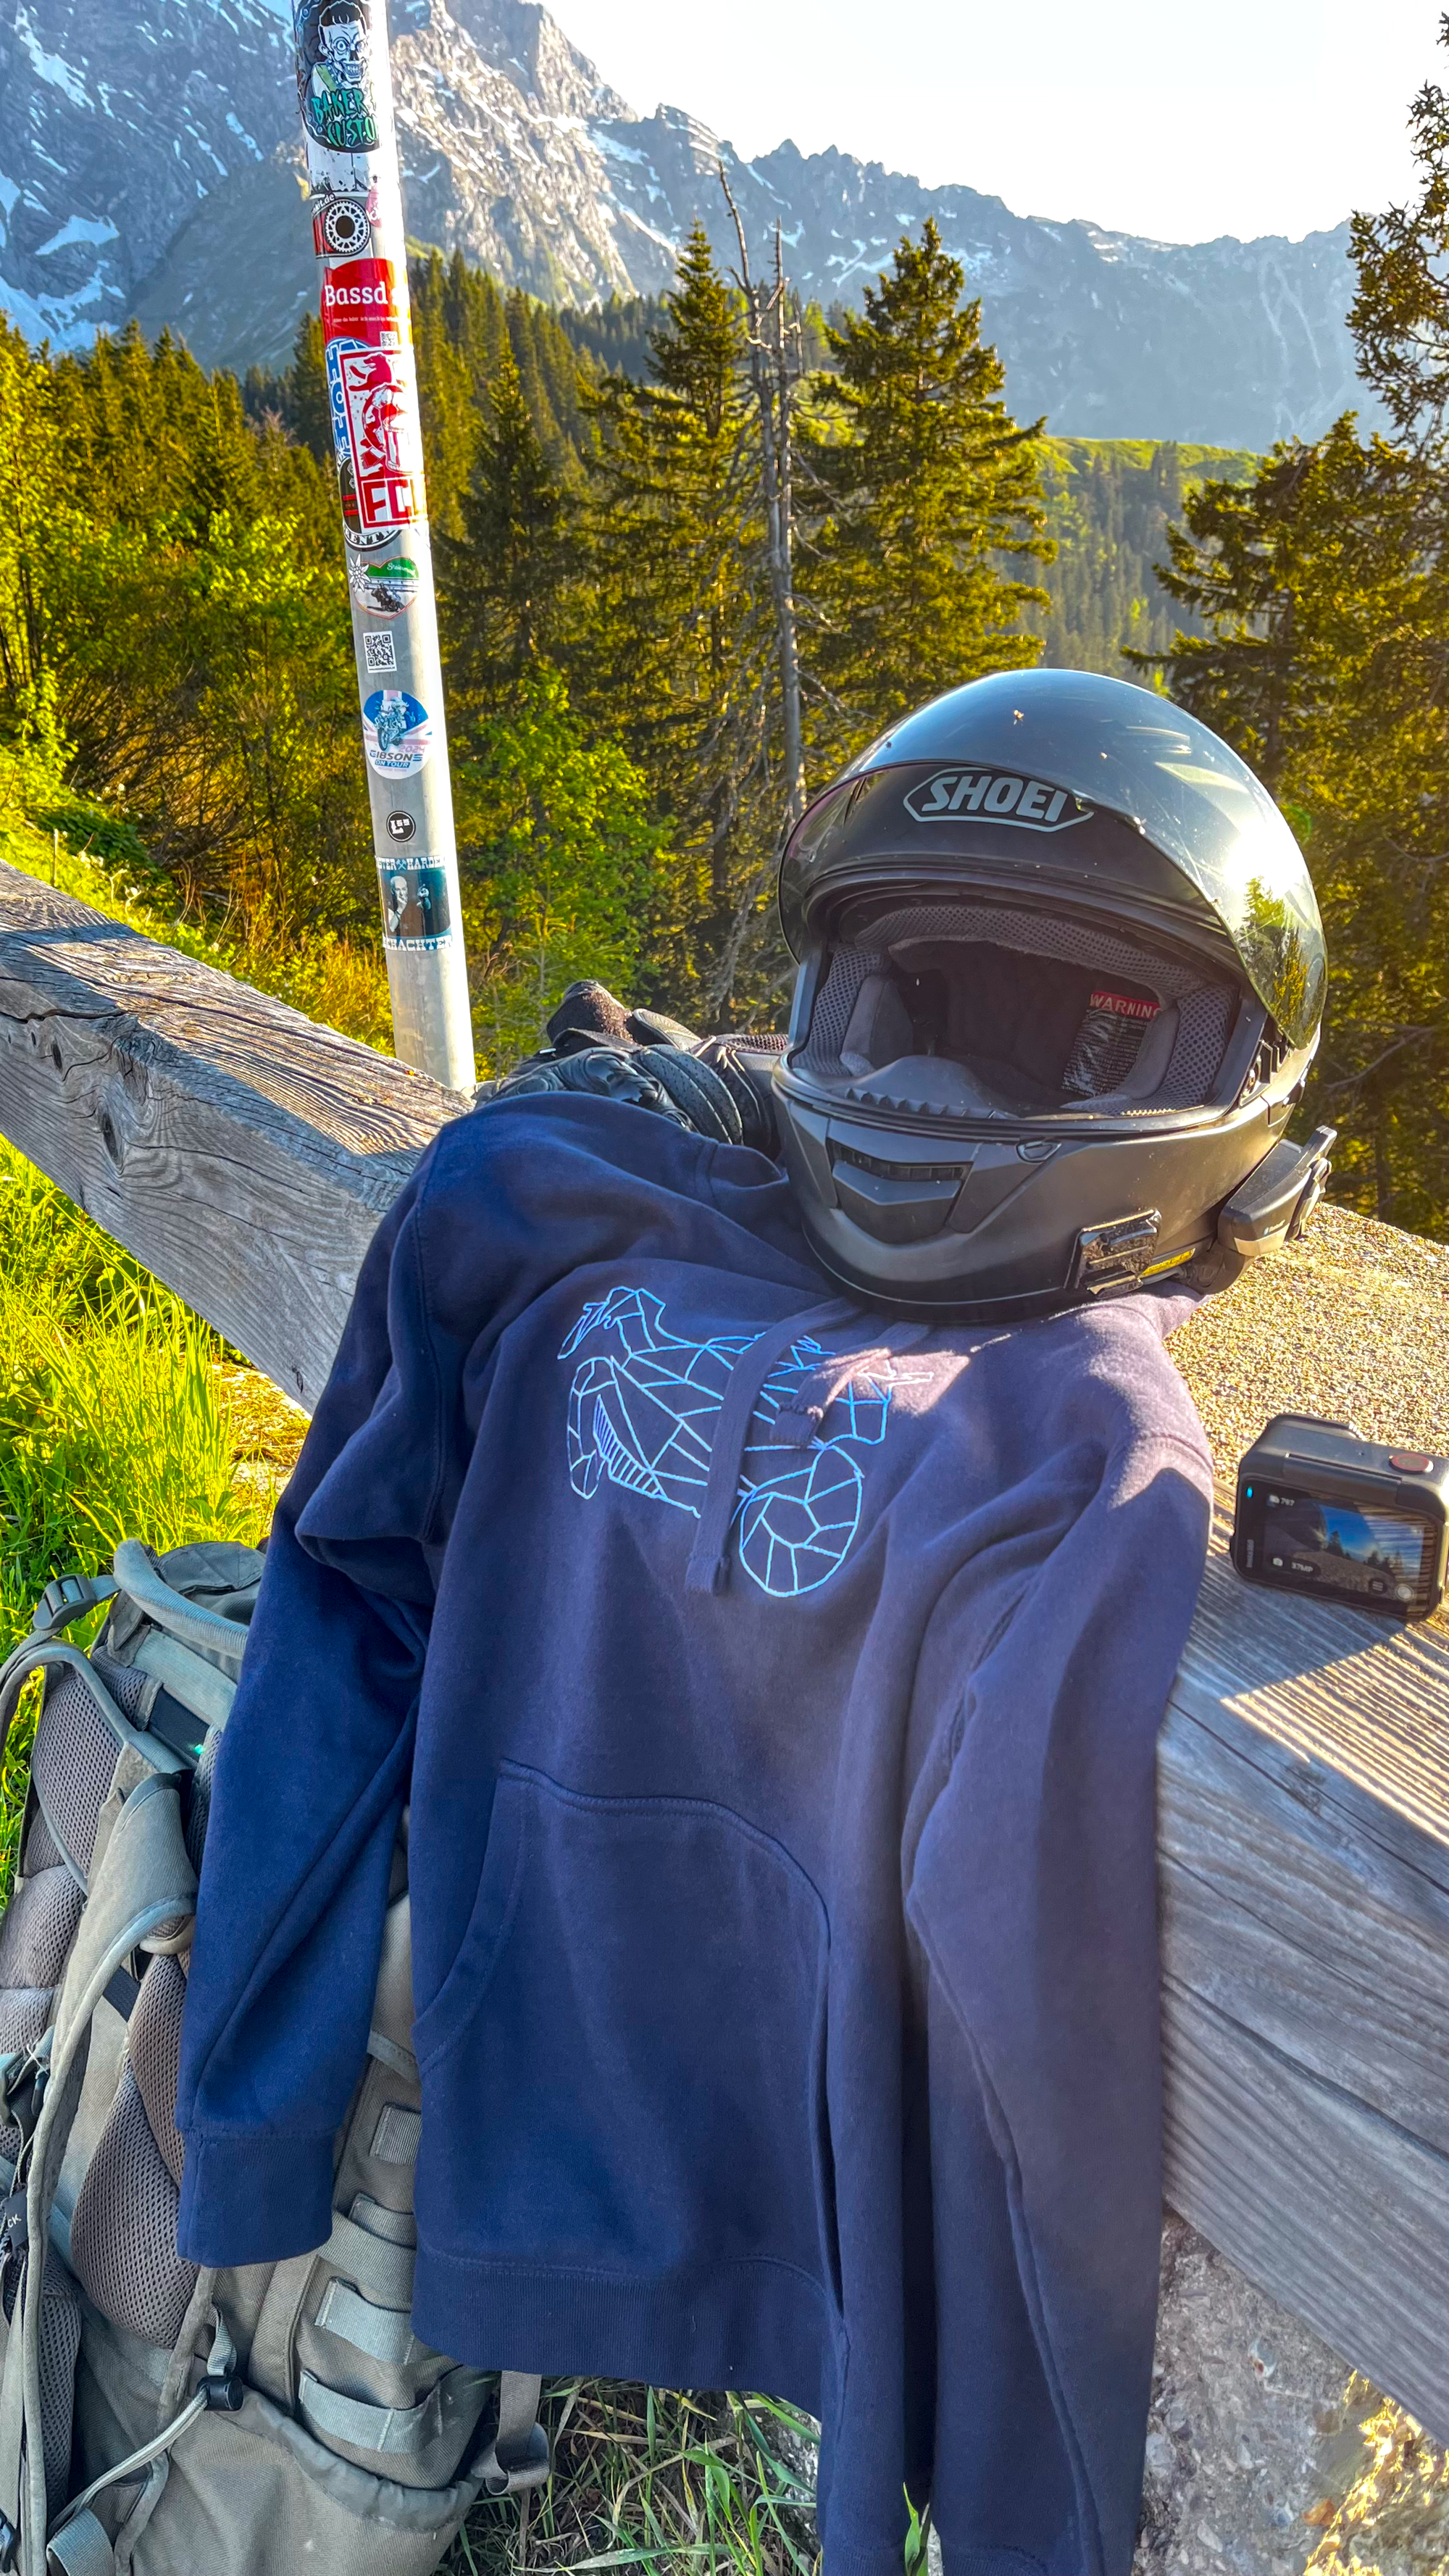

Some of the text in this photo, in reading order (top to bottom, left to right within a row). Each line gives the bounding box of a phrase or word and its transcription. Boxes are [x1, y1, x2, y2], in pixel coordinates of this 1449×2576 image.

[312, 88, 369, 125] BAKER
[325, 281, 388, 306] Bassd
[369, 750, 423, 762] GIBSONS
[922, 775, 1068, 822] SHOEI
